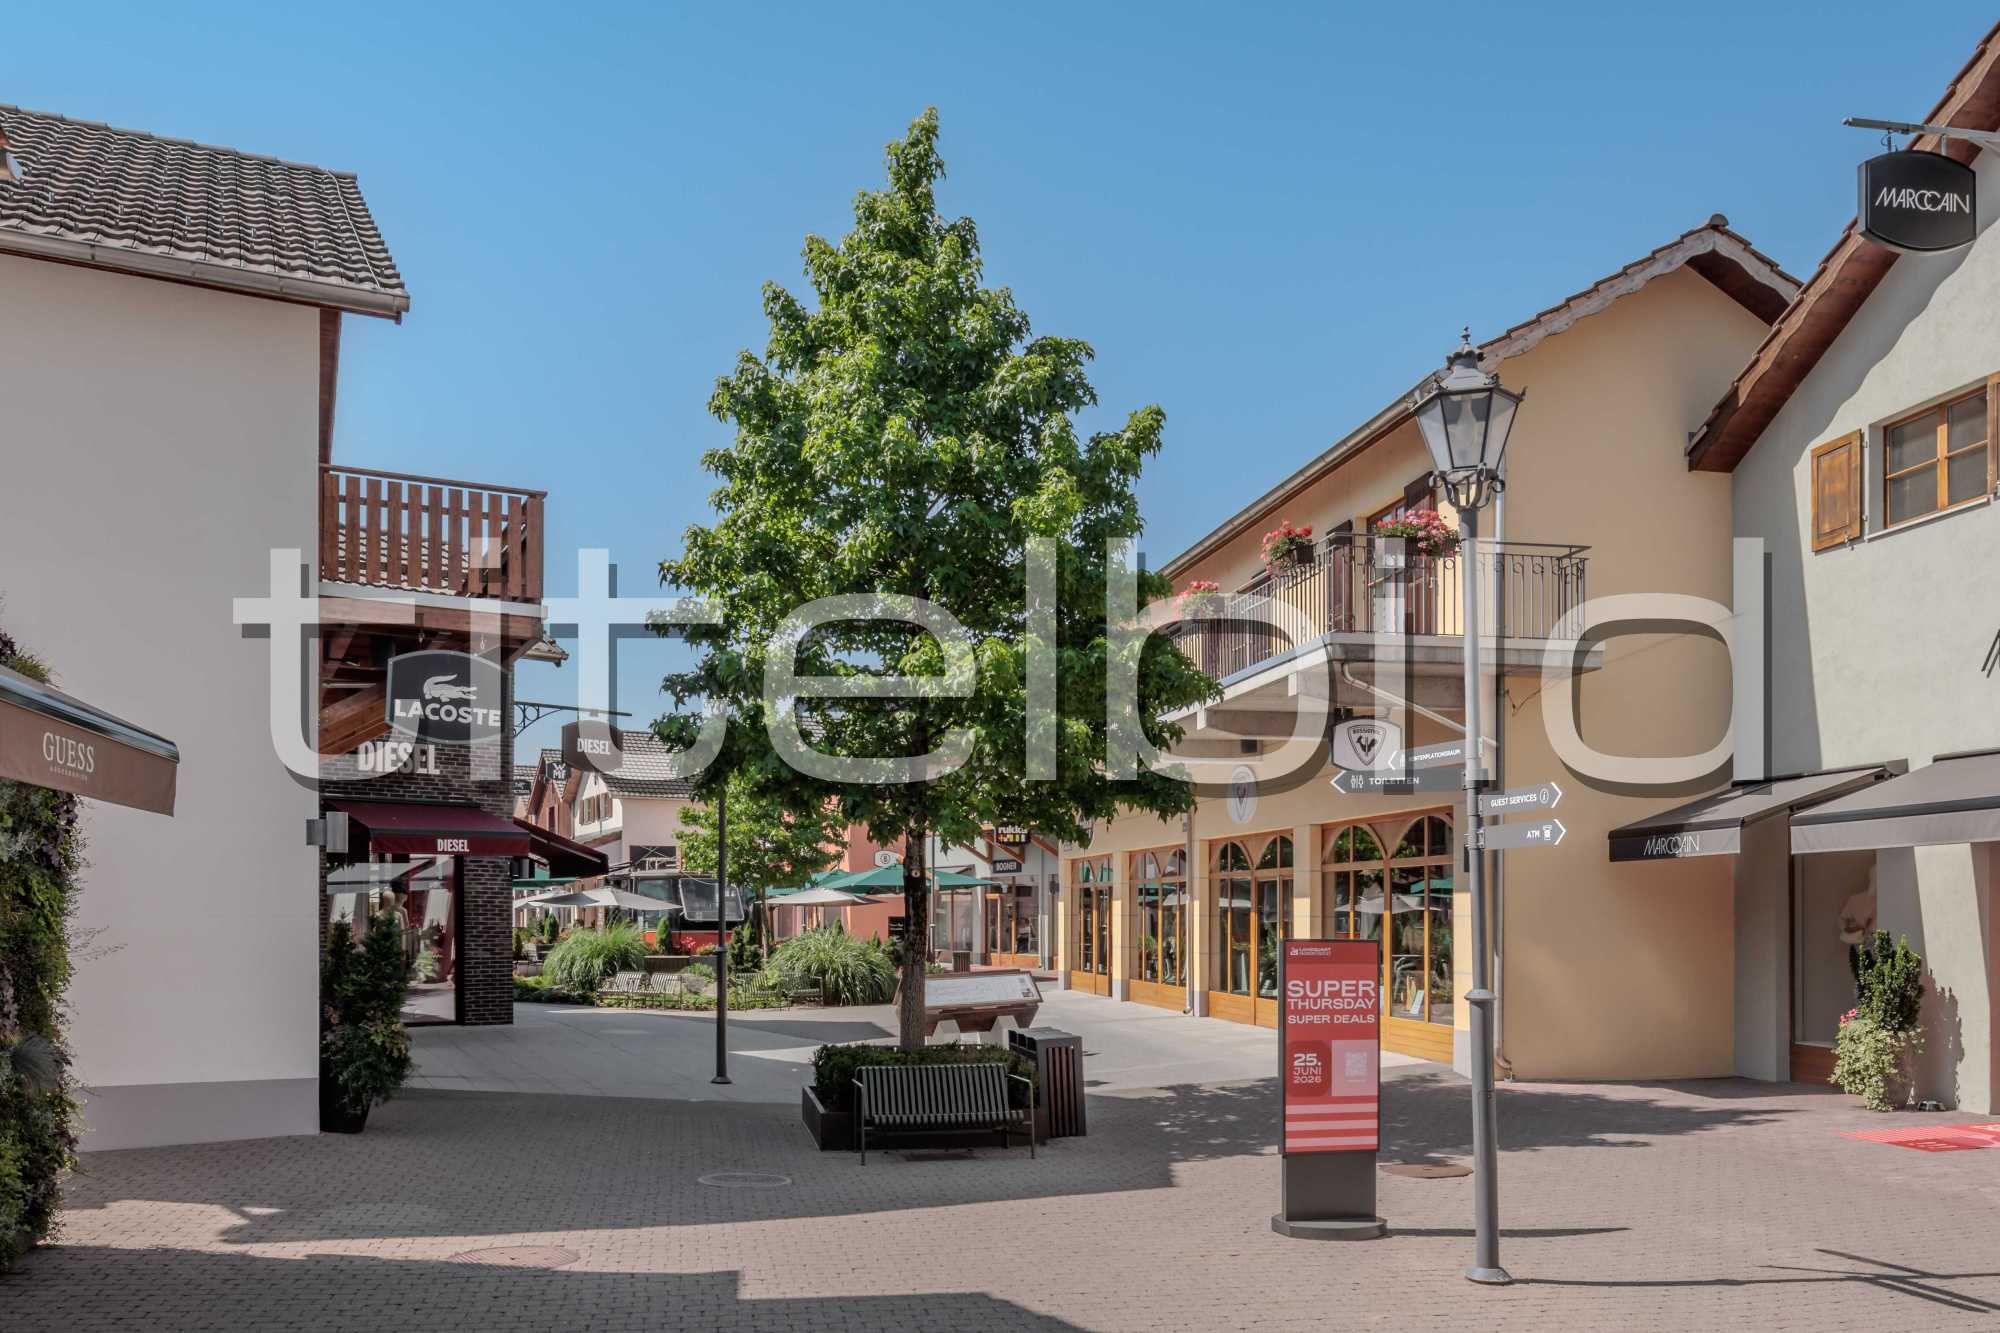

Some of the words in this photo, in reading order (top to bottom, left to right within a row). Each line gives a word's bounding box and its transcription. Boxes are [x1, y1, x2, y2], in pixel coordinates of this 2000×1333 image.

[394, 699, 501, 727] LACOSTE
[42, 731, 96, 773] GUESS
[577, 738, 610, 755] DIESEL
[357, 741, 440, 775] DIESEL
[1368, 777, 1420, 785] TOILETTEN
[1490, 797, 1508, 808] GUEST
[1509, 793, 1537, 805] SERVICES
[1526, 829, 1540, 839] ATM
[437, 839, 470, 852] DIESEL
[1287, 979, 1376, 998] SUPER
[1287, 998, 1376, 1010] THURSDAY
[1287, 1015, 1331, 1024] SUPER
[1333, 1014, 1376, 1024] DEALS
[1293, 1053, 1322, 1067] 25.
[1293, 1066, 1322, 1076] JUNI
[1293, 1075, 1322, 1084] 2026
